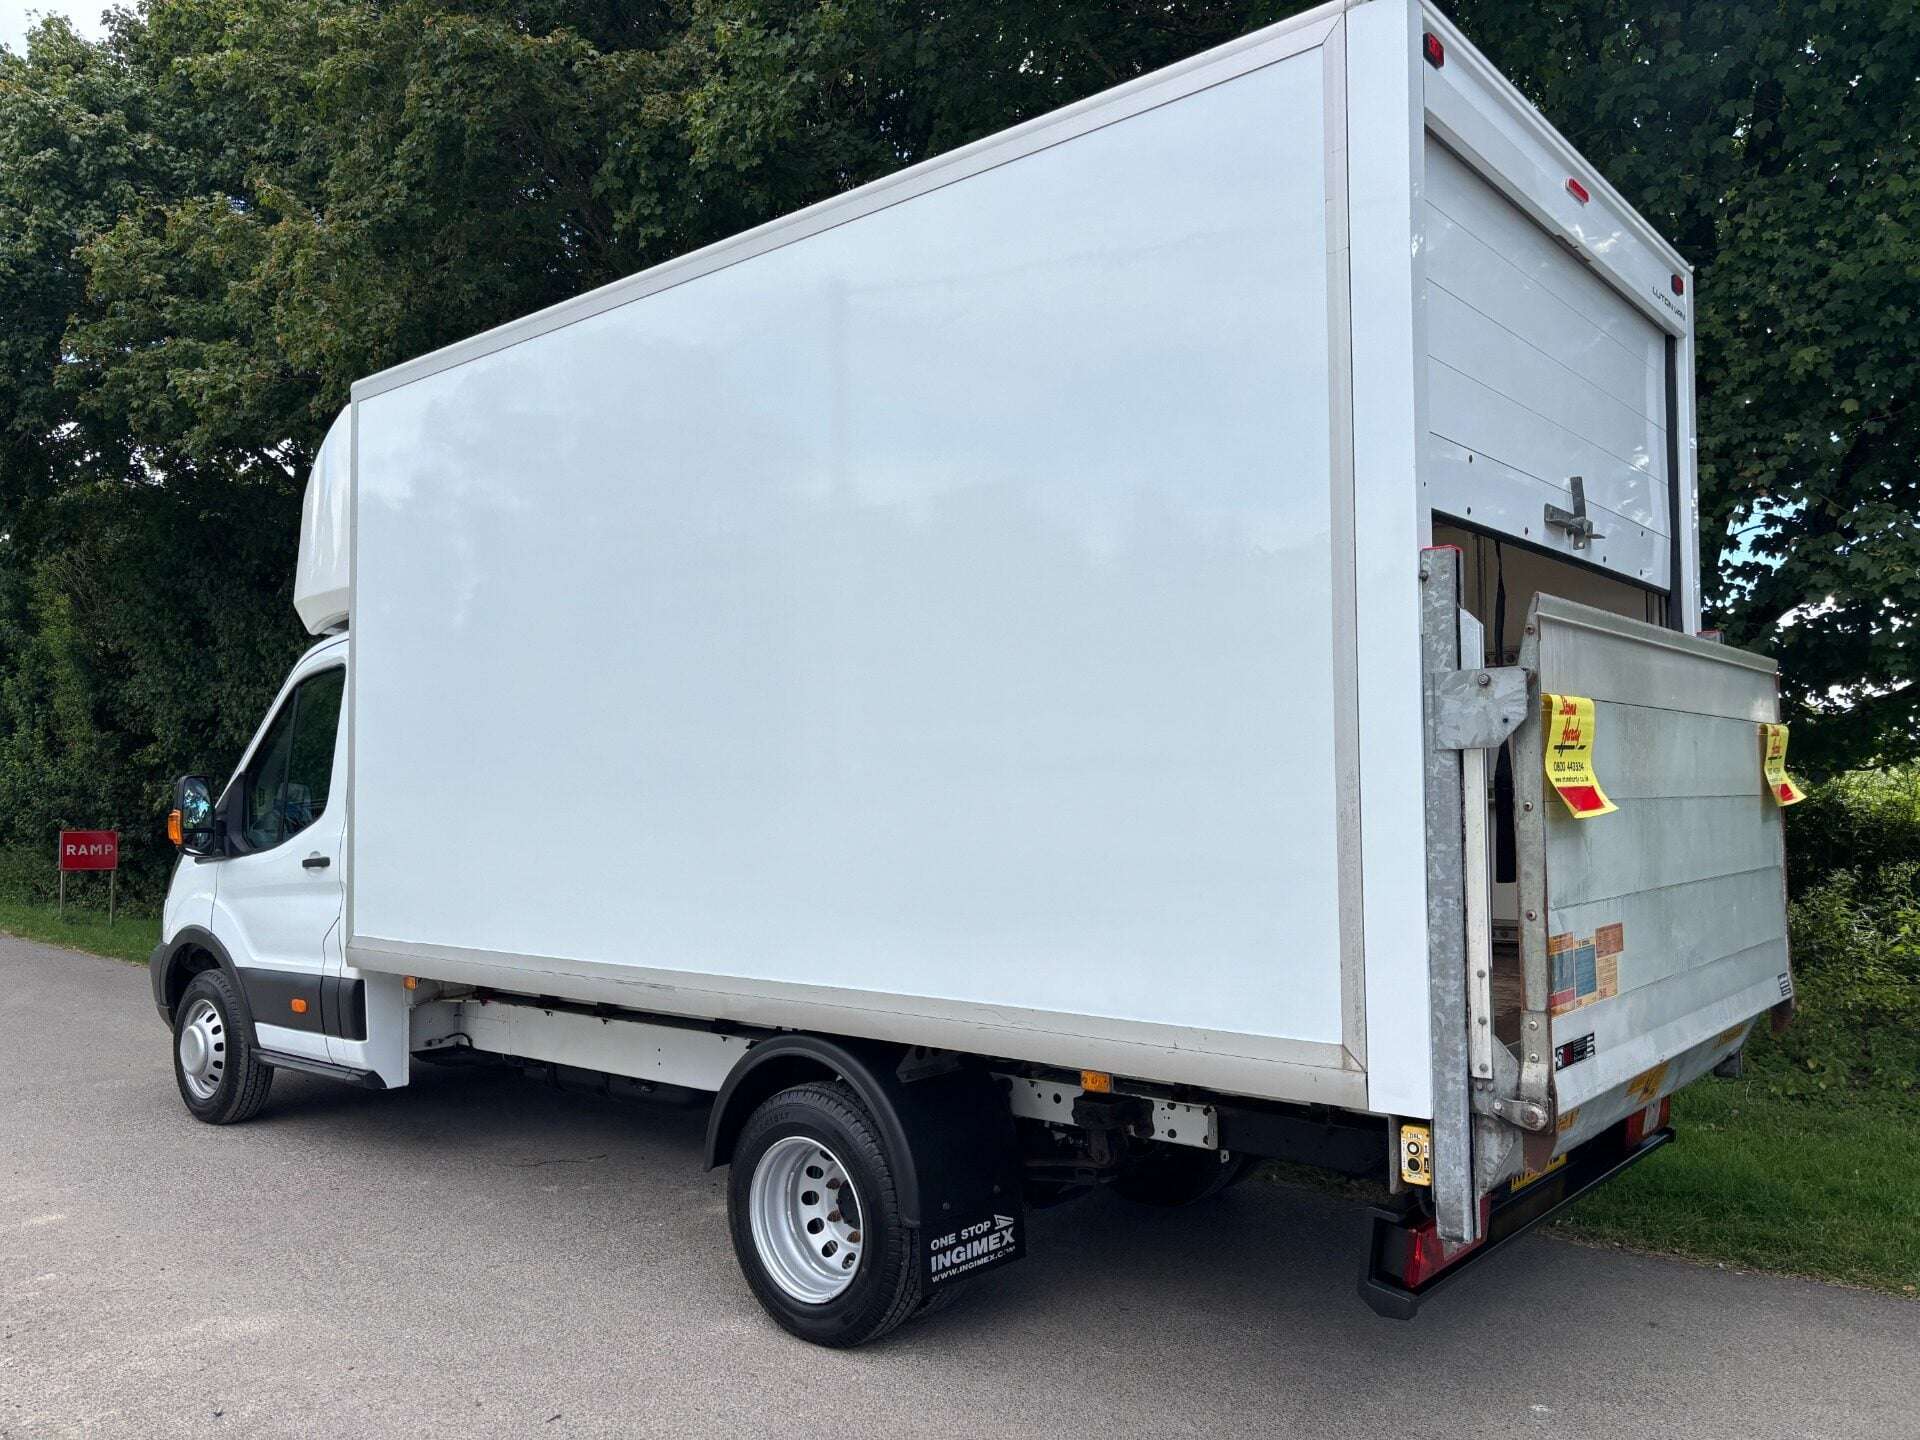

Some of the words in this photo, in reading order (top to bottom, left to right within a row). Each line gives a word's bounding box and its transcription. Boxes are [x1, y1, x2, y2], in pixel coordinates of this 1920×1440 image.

[66, 843, 114, 856] RAMP
[930, 1233, 957, 1251] ONE
[960, 1220, 991, 1240] STOP
[930, 1226, 1015, 1273] INGIMEX
[931, 1245, 1016, 1283] WWW.INGIMEX.CM
